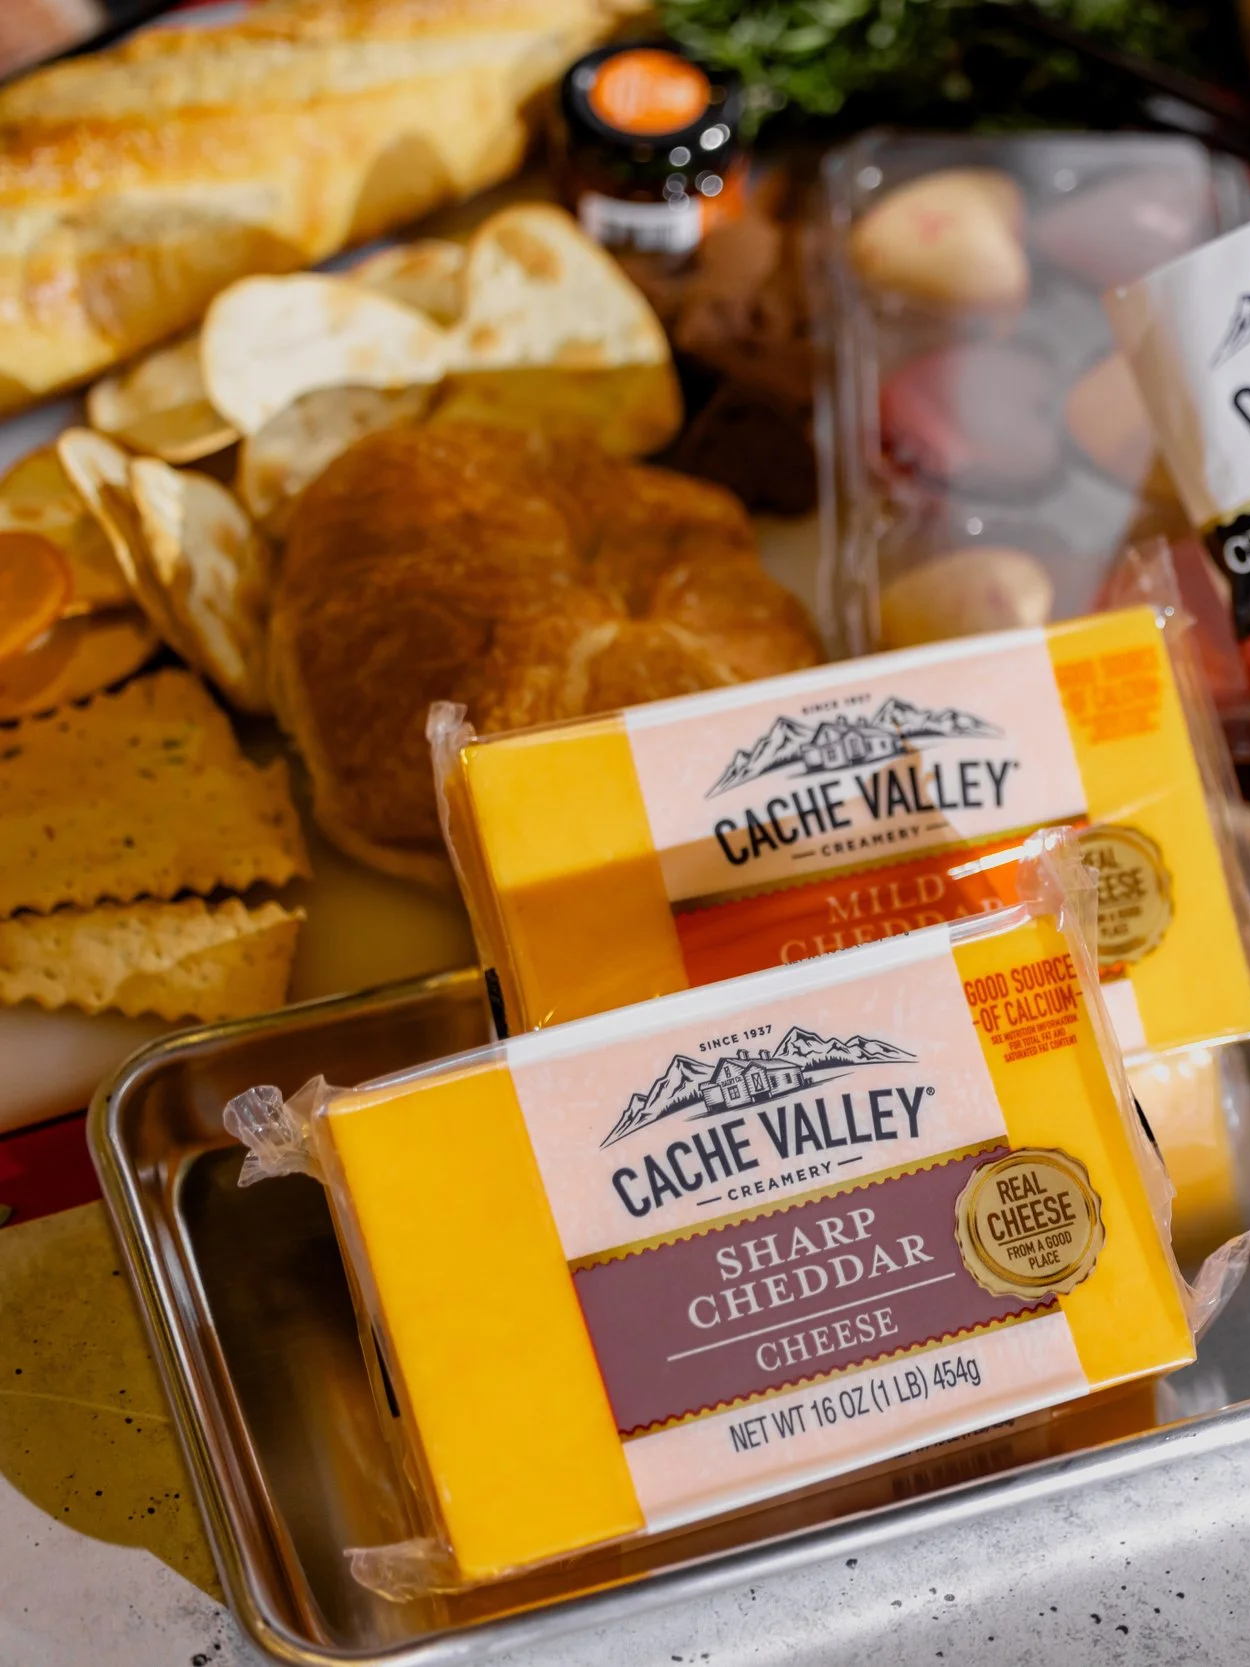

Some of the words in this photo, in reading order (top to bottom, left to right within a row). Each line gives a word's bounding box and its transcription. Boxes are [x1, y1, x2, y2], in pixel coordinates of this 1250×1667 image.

[713, 780, 851, 868] CACHE
[820, 825, 921, 859] CREAMERY
[827, 873, 945, 924] MILD
[963, 972, 1009, 1007] GOOD
[1010, 953, 1077, 994] SOURCE
[699, 1034, 740, 1051] SINCE
[743, 1024, 773, 1040] 1937
[612, 1117, 760, 1218] CACHE
[727, 1160, 832, 1201] CREAMERY
[996, 1170, 1048, 1205] REAL
[986, 1191, 1077, 1242] CHEESE
[715, 1207, 876, 1282] SHARP
[1006, 1240, 1036, 1261] FROM
[1037, 1241, 1046, 1252] A
[1045, 1231, 1072, 1250] GOOD
[1028, 1251, 1060, 1270] PLACE
[688, 1234, 934, 1329] CHEDDAR
[755, 1306, 899, 1372] CHEESE
[729, 1415, 768, 1453] NET
[771, 1404, 806, 1439] WT
[810, 1397, 837, 1427] 16
[840, 1387, 870, 1418] OZ
[870, 1379, 892, 1413] (1
[894, 1366, 929, 1403] LB)
[932, 1355, 982, 1390] 454g
